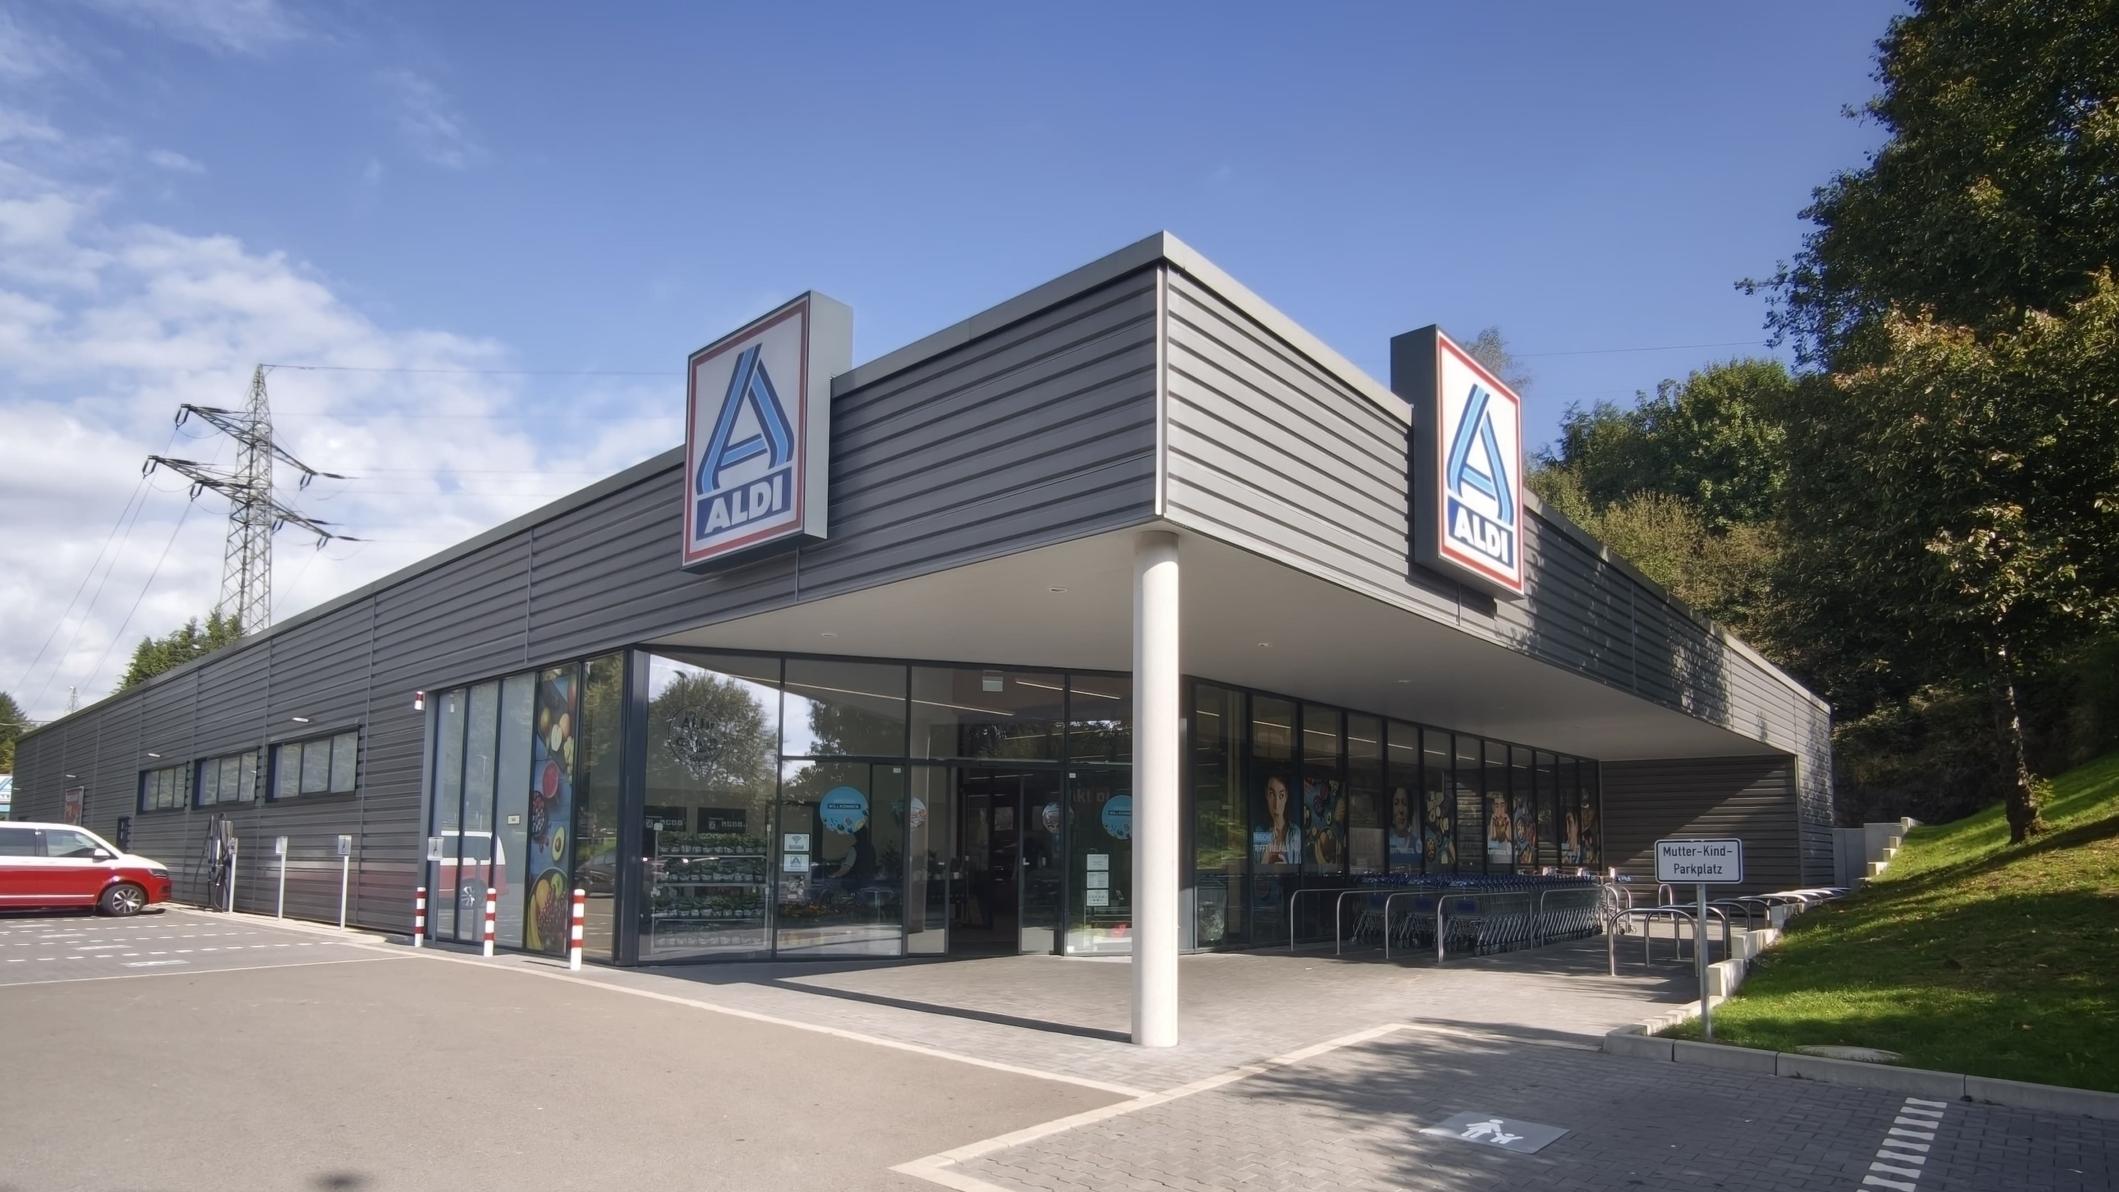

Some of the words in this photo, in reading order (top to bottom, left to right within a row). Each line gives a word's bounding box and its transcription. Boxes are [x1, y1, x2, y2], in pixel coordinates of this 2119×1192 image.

[704, 474, 783, 534] ALDI
[1453, 506, 1509, 564] ALDI
[1662, 845, 1733, 857] Mutter-Kind-
[1673, 863, 1723, 876] Parkplatz
